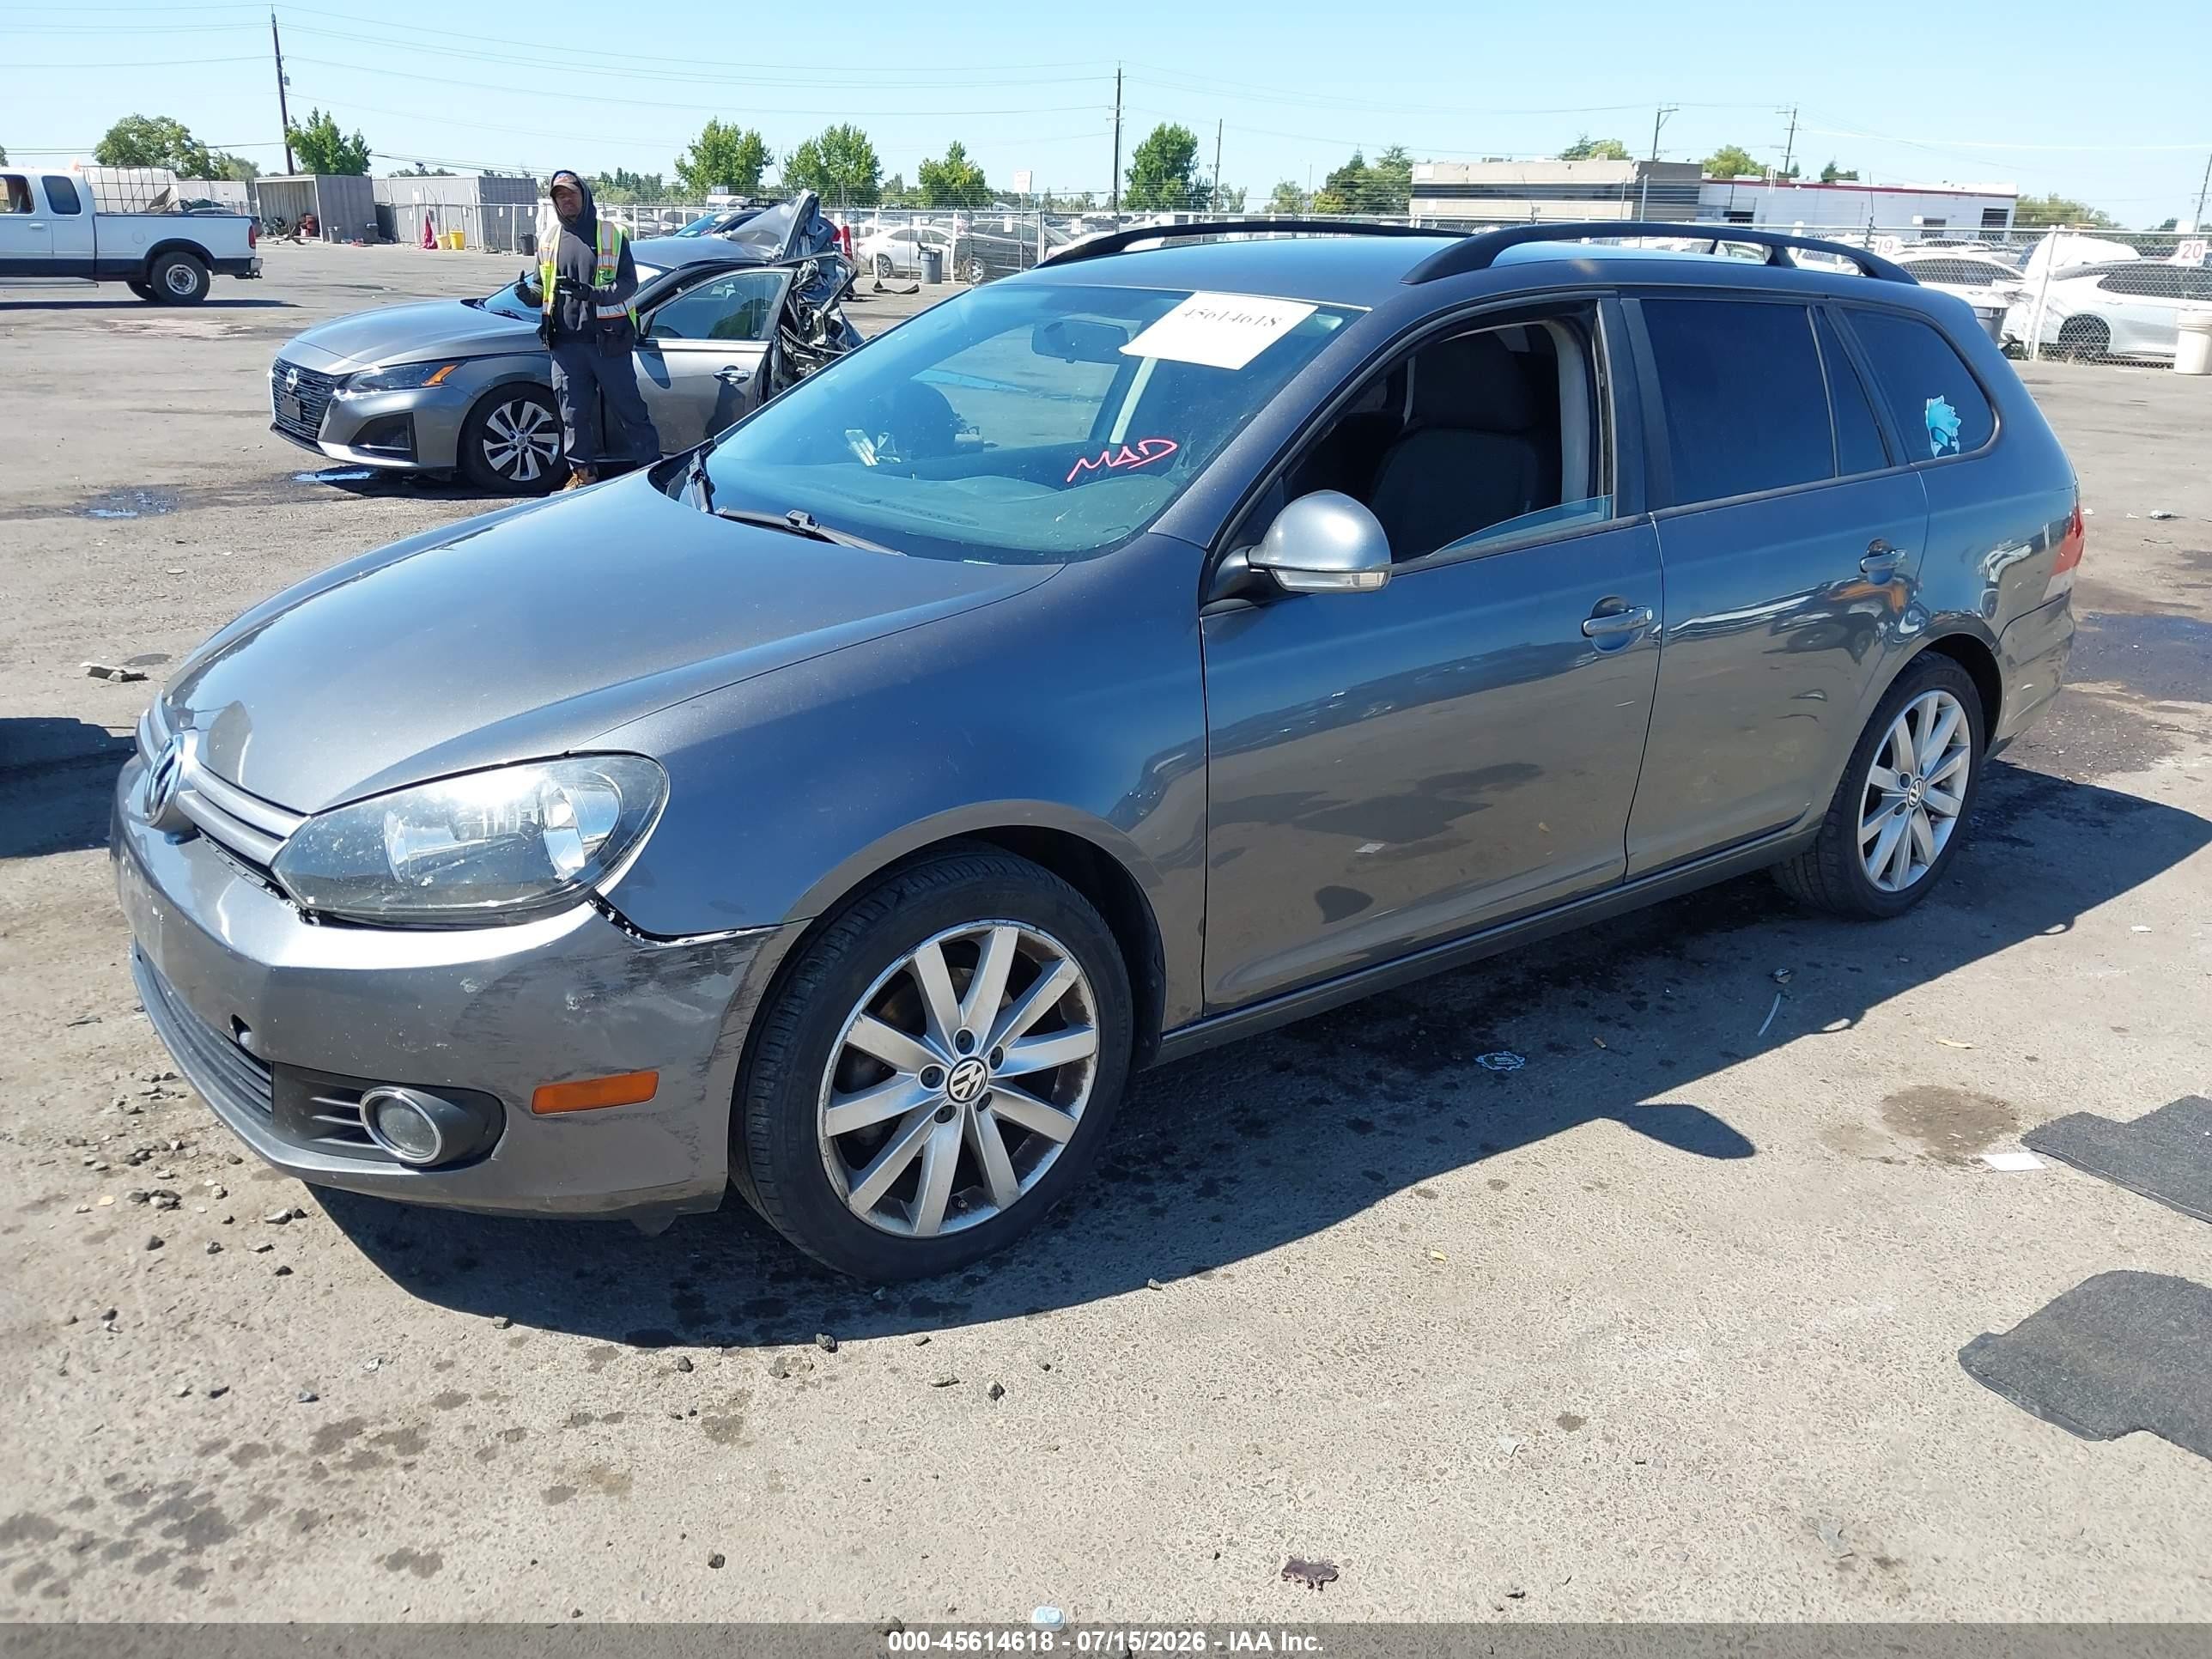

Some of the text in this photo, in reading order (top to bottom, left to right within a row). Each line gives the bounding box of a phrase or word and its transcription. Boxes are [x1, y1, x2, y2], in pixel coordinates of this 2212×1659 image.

[1877, 240, 1893, 253] 19
[2181, 243, 2203, 259] 20
[1066, 439, 1178, 483] MAD
